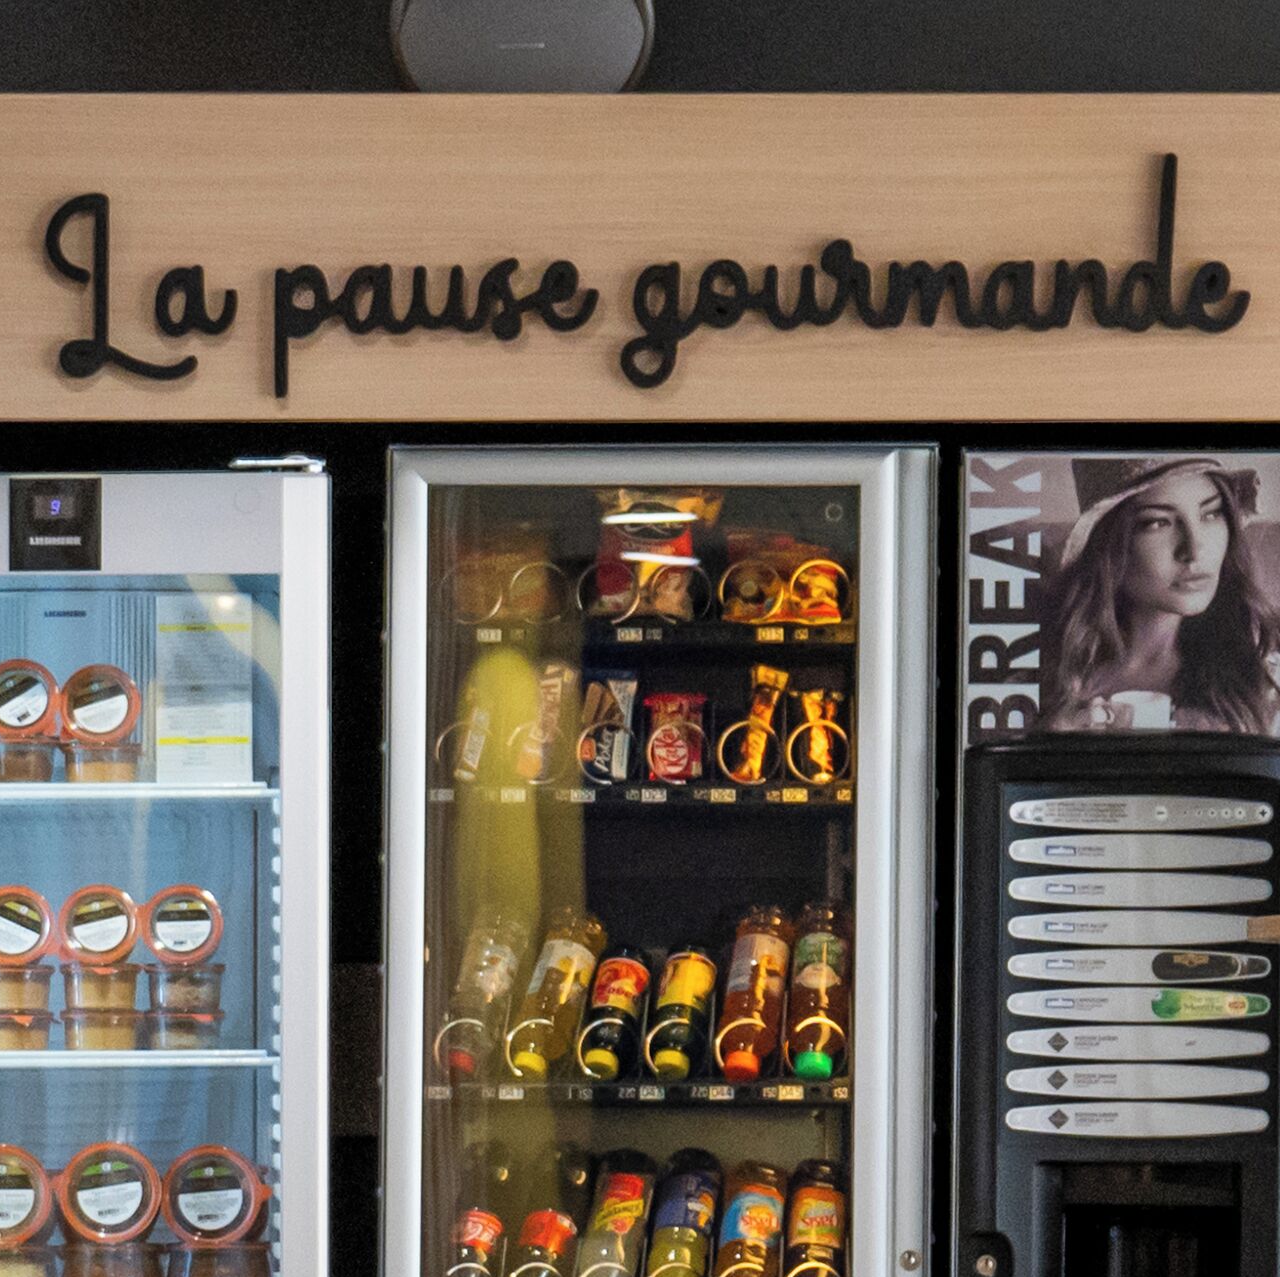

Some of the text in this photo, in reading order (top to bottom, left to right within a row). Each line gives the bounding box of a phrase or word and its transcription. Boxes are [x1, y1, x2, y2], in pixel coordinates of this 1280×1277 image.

[43, 152, 1252, 398] La pause gourmande
[967, 456, 1042, 741] BREAK
